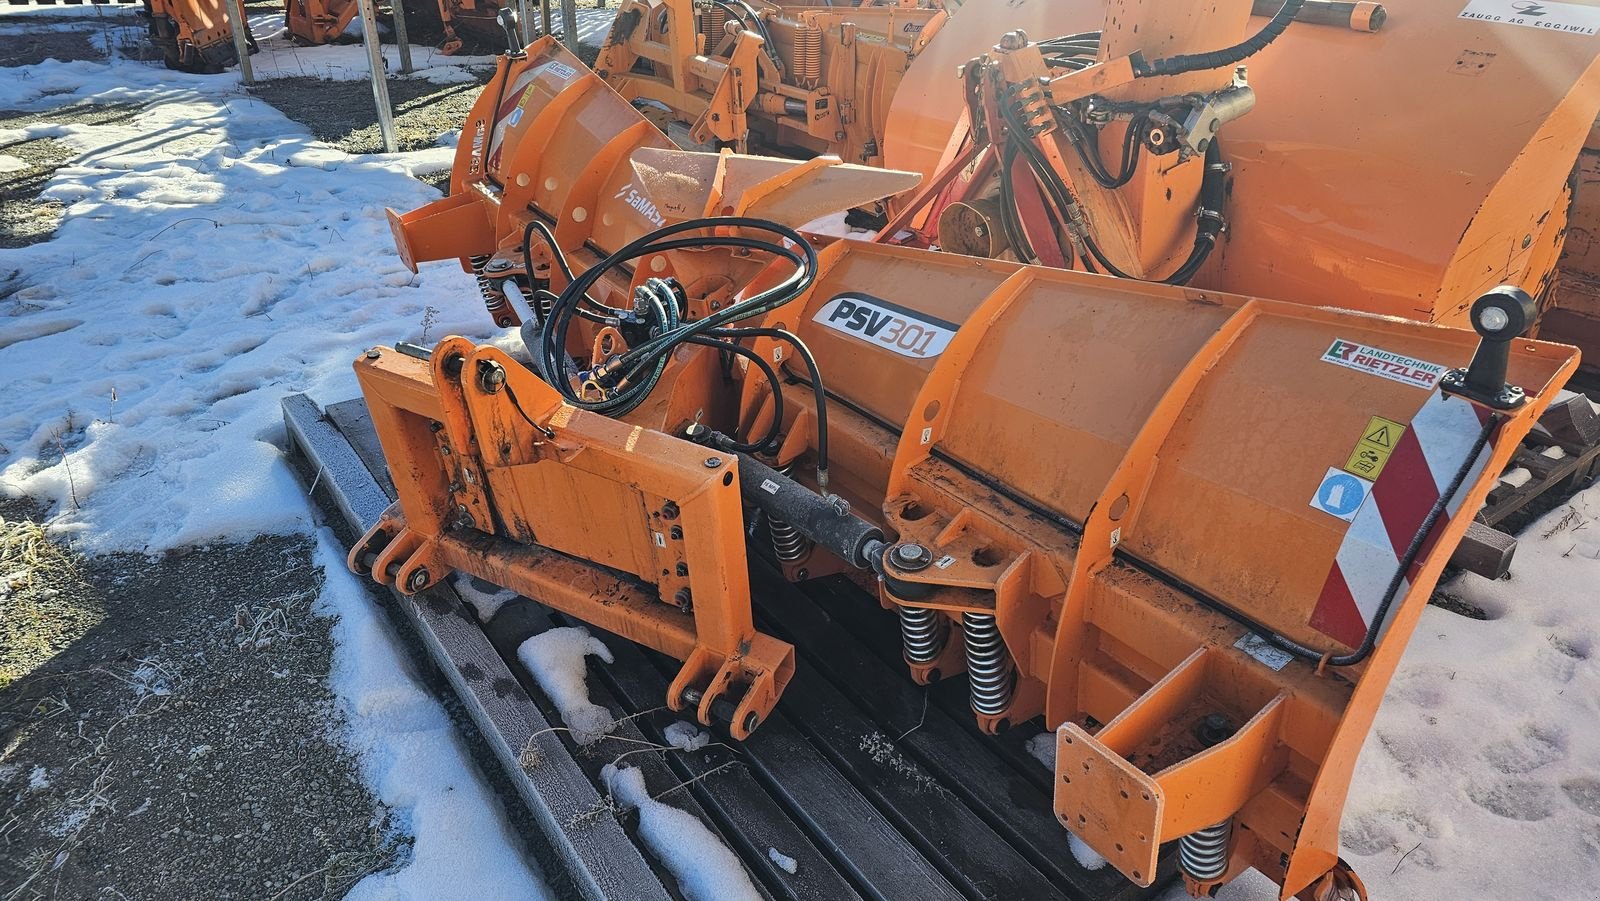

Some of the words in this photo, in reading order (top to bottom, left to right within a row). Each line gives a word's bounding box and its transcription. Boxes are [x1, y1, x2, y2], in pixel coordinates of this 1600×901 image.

[1461, 11, 1501, 21] ZAUGG
[1534, 21, 1594, 34] EGGIWIL
[828, 299, 937, 357] PSV301
[1352, 354, 1437, 384] RIETZLER
[1359, 346, 1441, 374] LANDTECHNIK
